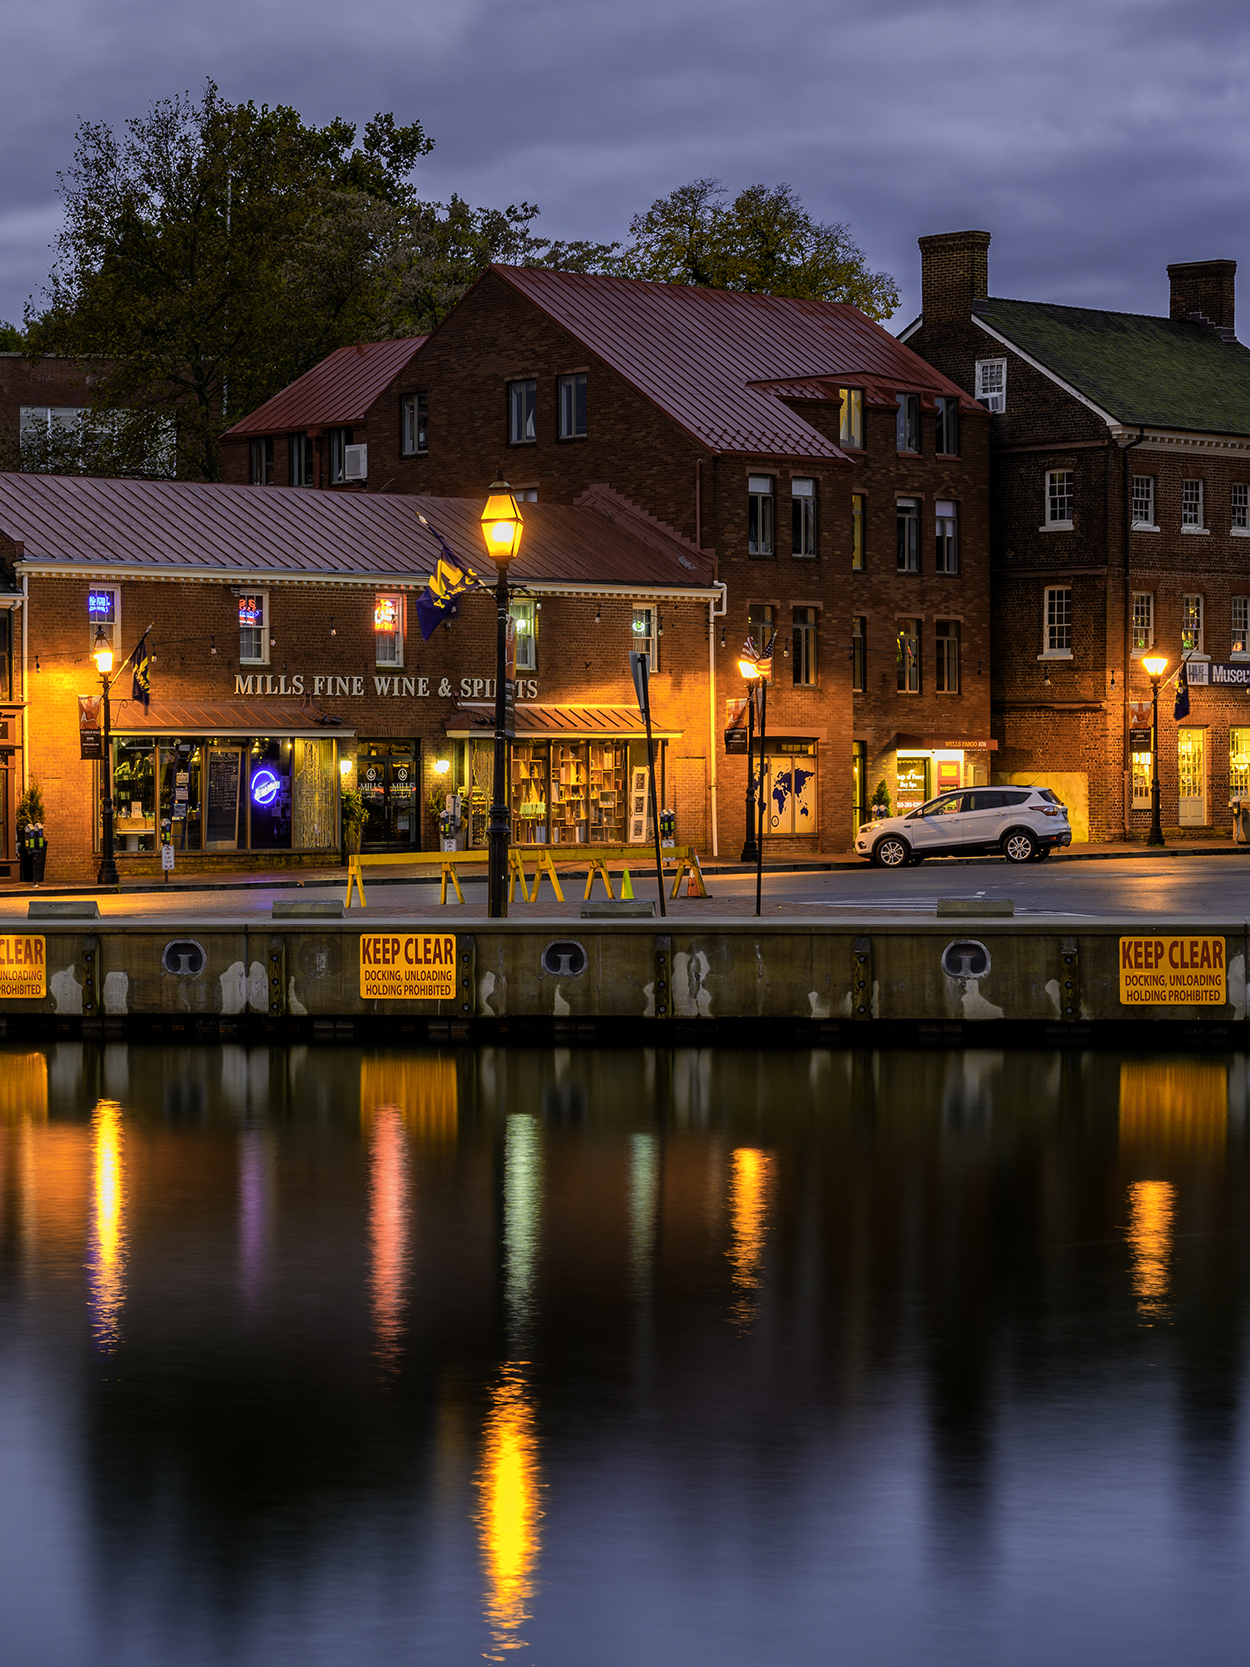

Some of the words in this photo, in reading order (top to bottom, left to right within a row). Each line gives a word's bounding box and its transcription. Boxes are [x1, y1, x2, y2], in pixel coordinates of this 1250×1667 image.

[234, 674, 304, 695] MILLS
[312, 676, 364, 696] FINE
[372, 676, 430, 696] WINE
[438, 678, 452, 697] &
[460, 678, 538, 698] SPITS
[362, 938, 400, 964] KEEP
[404, 938, 453, 964] CLEAR
[1122, 941, 1164, 969] KEEP
[1169, 941, 1223, 969] CLEAR
[365, 970, 403, 982] DOCKING,
[405, 970, 452, 981] UNLOADING
[1125, 975, 1167, 987] DOCKING,
[1169, 975, 1221, 986] UNLOADING
[366, 985, 402, 995] HOLDING
[404, 985, 450, 995] PROHIBITED
[1126, 990, 1166, 1001] HOLDING
[1168, 990, 1220, 1001] PROHIBITED
